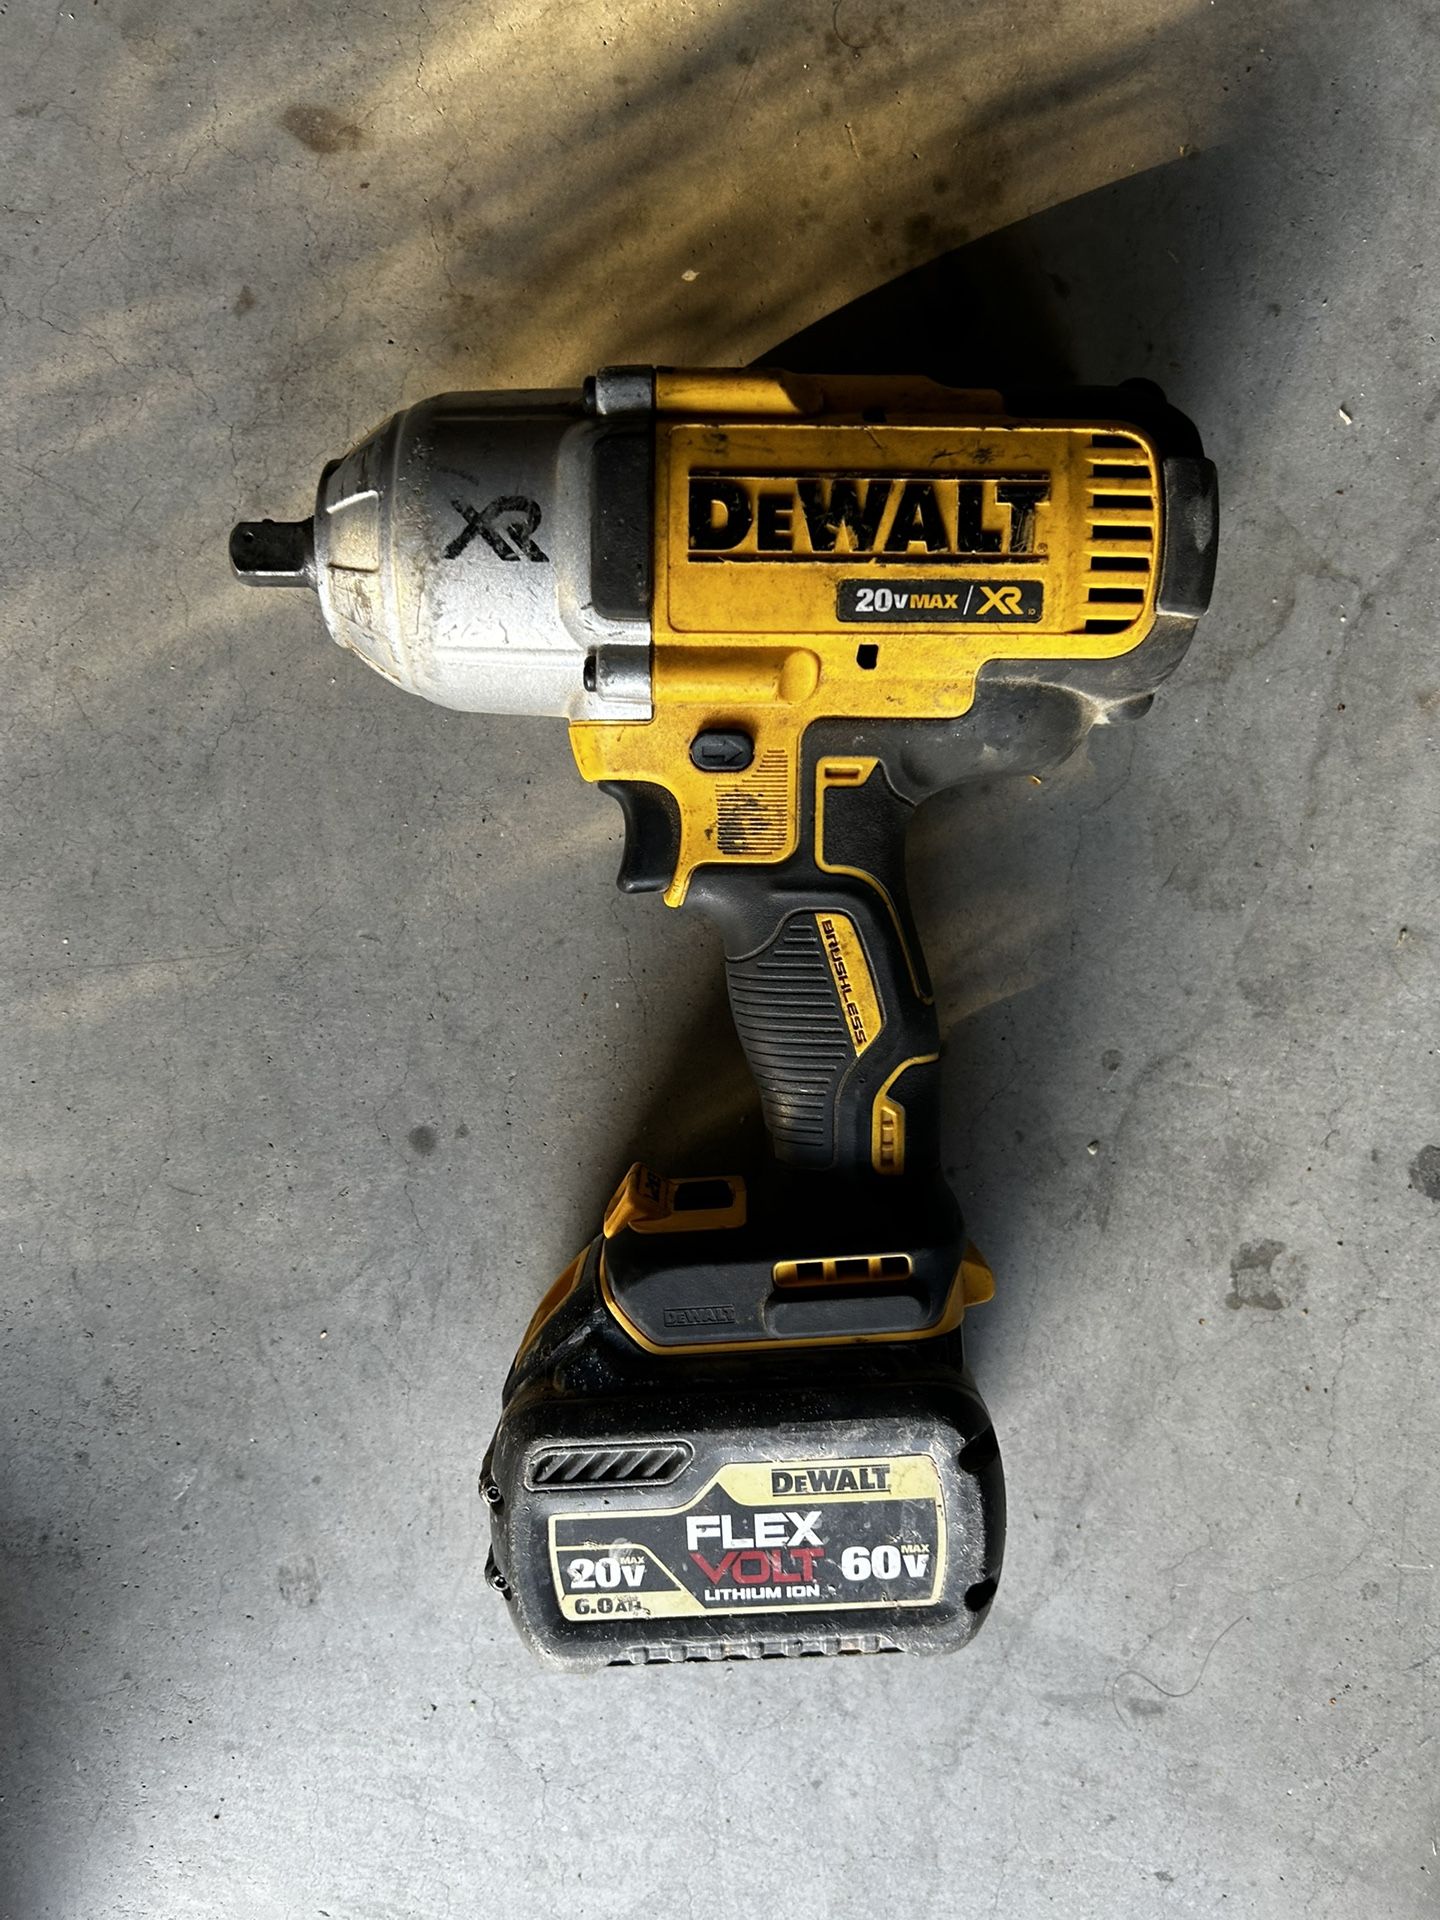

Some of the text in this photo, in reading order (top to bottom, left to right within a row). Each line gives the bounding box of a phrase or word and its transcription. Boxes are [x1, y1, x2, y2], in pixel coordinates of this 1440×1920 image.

[443, 496, 550, 562] XR
[688, 478, 1051, 554] DEWALT
[909, 594, 959, 609] MAX
[976, 586, 1024, 615] XR
[820, 919, 868, 1046] BRUSHLESS
[664, 1306, 736, 1326] DEWALT
[771, 1467, 891, 1493] DEWALT
[686, 1510, 824, 1551] FLEX
[620, 1556, 646, 1565] MAX
[901, 1543, 930, 1554] MAX
[690, 1547, 826, 1585] VOLT
[704, 1584, 820, 1601] LITHIUM ION
